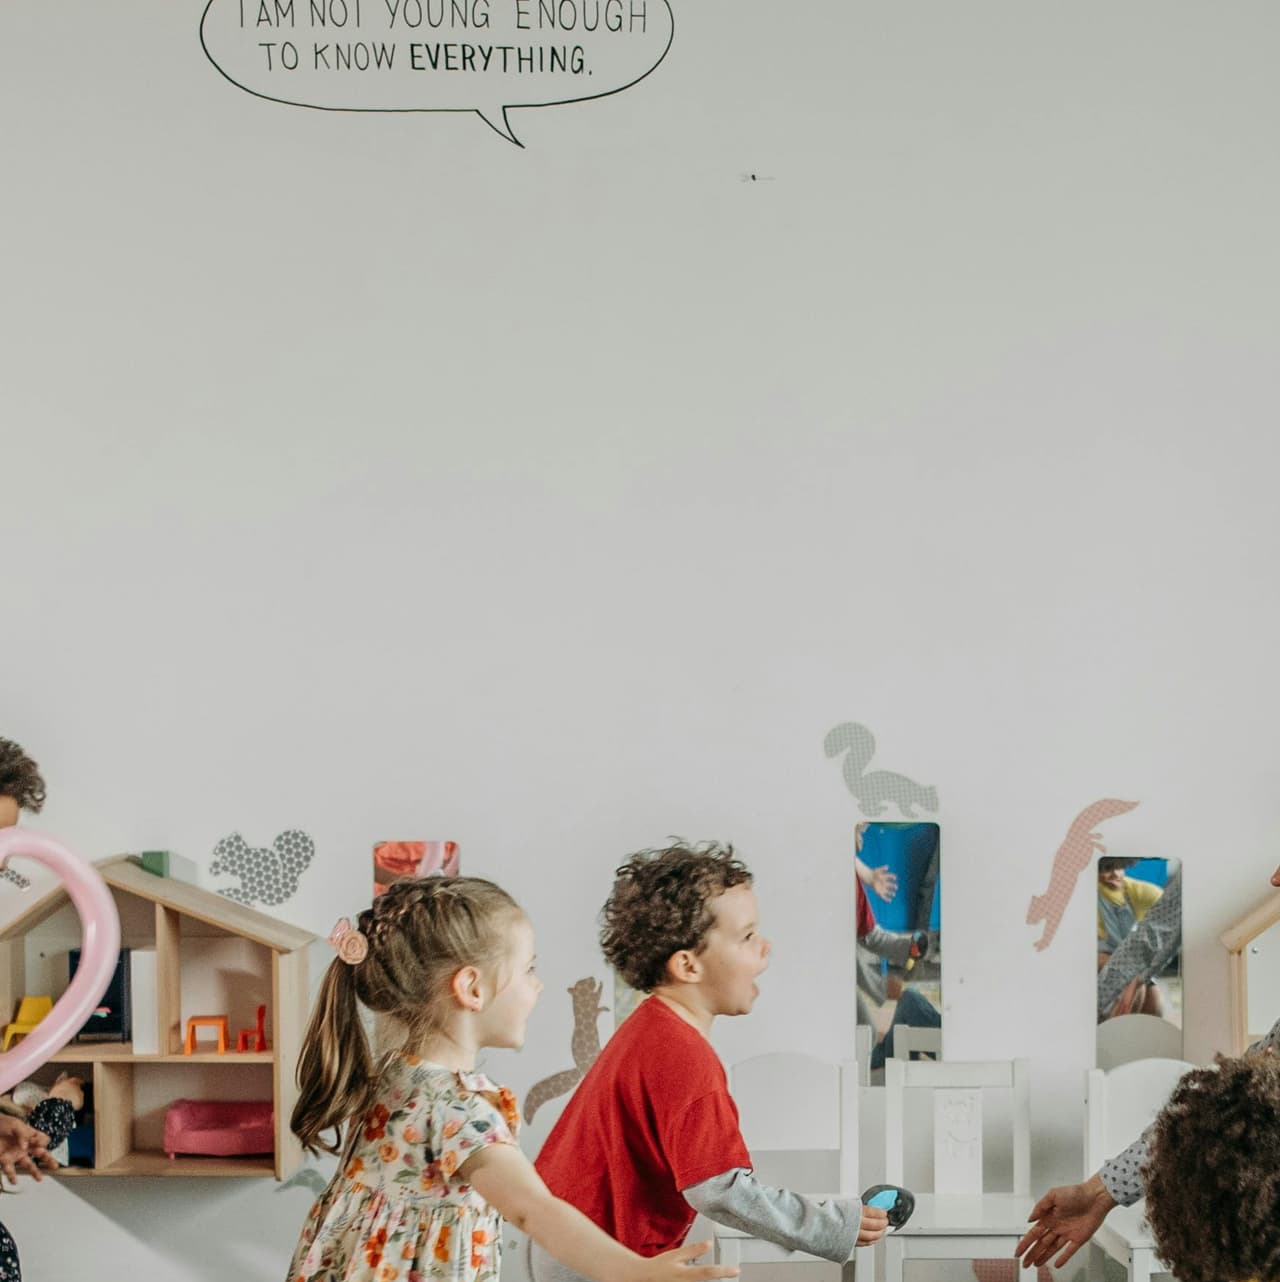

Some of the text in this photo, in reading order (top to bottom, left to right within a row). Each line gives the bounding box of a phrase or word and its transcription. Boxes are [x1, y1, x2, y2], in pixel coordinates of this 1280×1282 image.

[240, 0, 244, 28] I
[256, 0, 295, 28] AM
[384, 0, 490, 29] YOUNG
[516, 0, 647, 33] ENOUGH
[258, 41, 593, 76] TO KNOW EVERYTHING.
